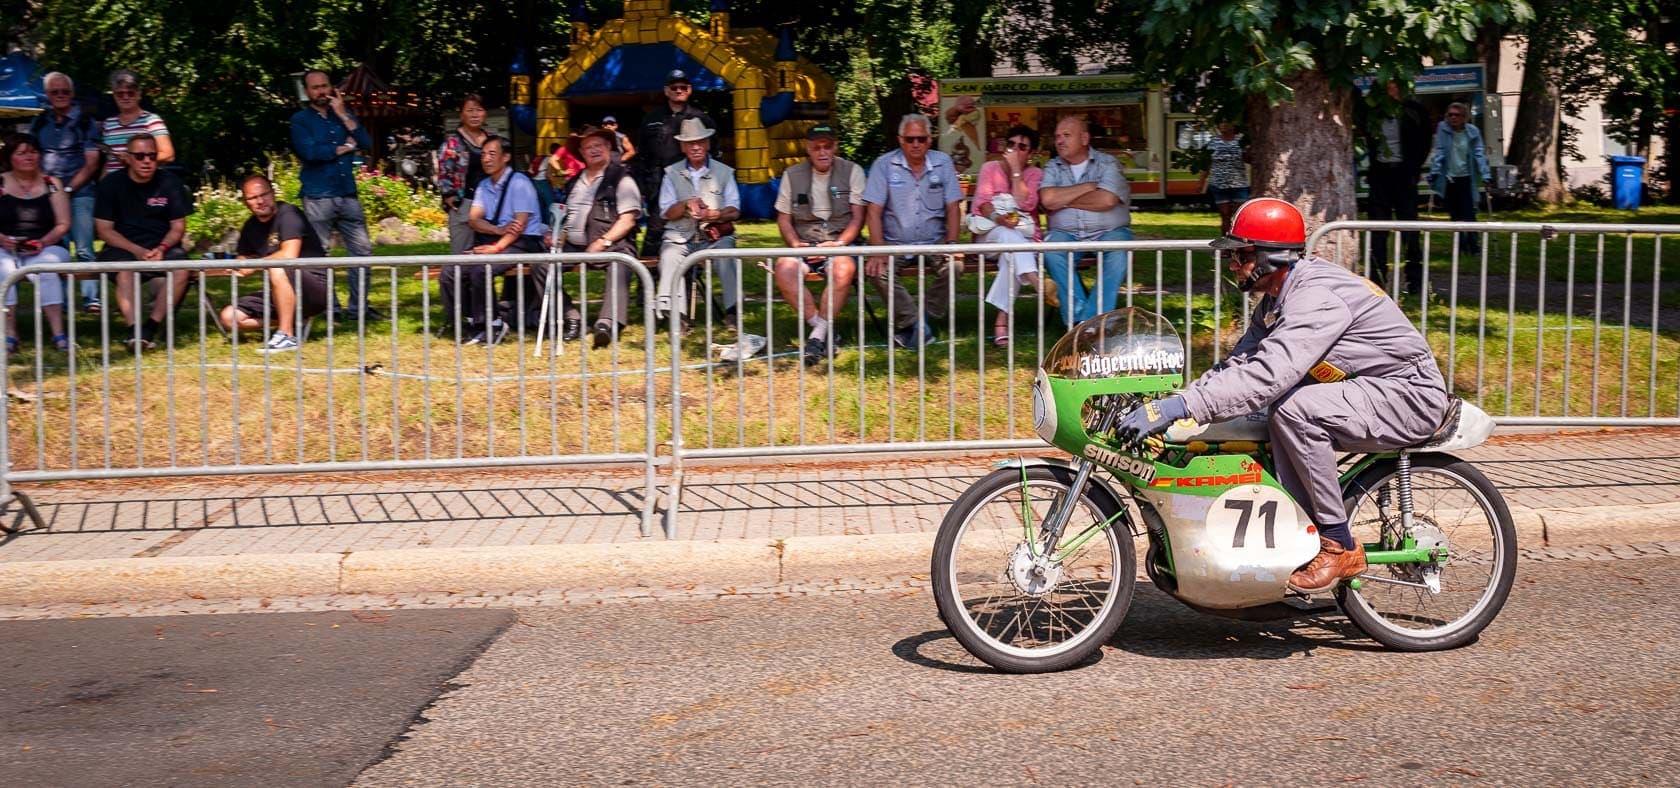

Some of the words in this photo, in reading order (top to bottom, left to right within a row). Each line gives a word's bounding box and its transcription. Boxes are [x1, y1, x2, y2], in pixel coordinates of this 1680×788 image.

[952, 84, 977, 93] SAN
[982, 83, 1029, 92] MARCO
[1176, 472, 1262, 487] KAMEI
[1224, 499, 1278, 549] 71
